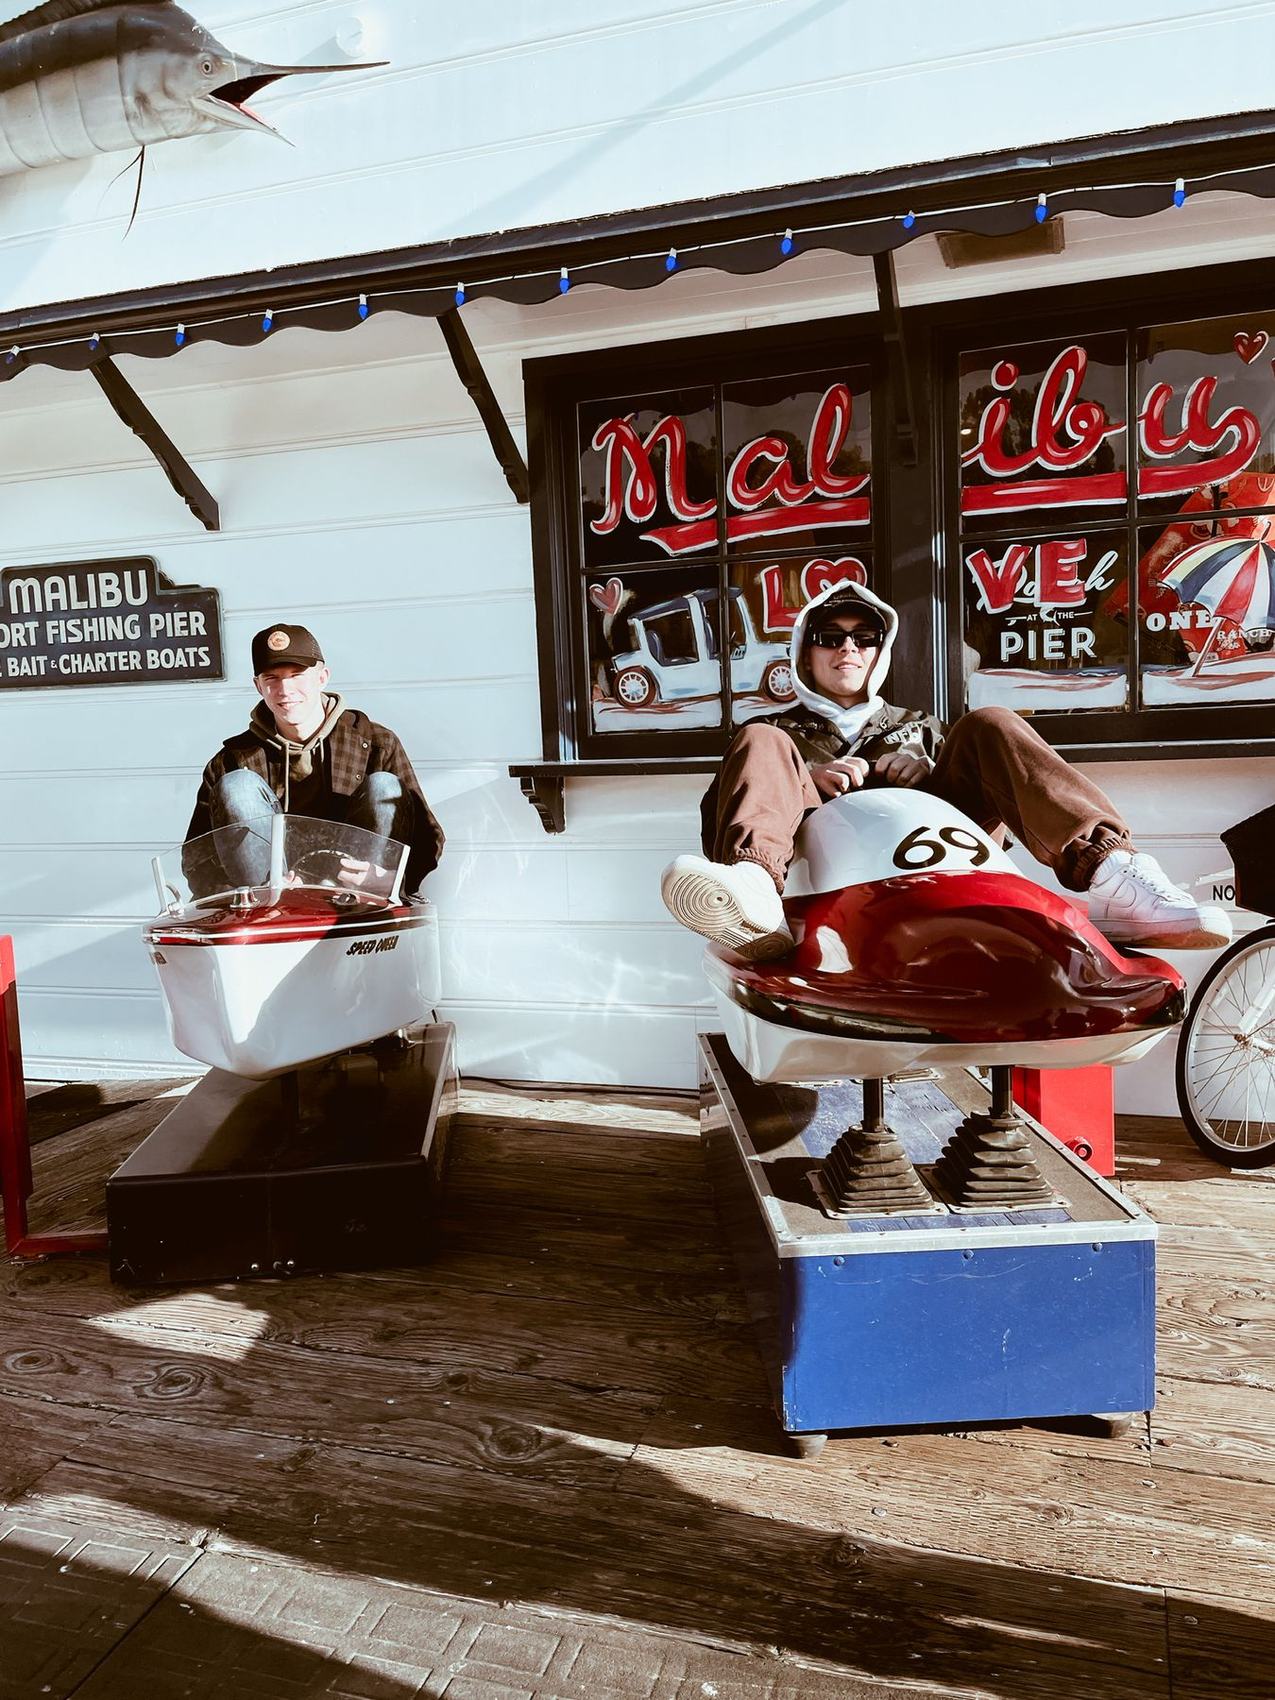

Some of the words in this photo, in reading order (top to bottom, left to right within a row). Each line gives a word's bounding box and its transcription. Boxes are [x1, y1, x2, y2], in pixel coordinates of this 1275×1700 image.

[9, 569, 148, 614] MALIBU
[46, 613, 141, 644] FISHING
[150, 611, 207, 638] PIER
[1026, 613, 1038, 621] AT
[1057, 611, 1075, 620] THE
[1146, 610, 1214, 632] ONE
[1000, 627, 1098, 663] PIER
[7, 655, 48, 677] BAIT
[50, 660, 58, 669] &
[59, 650, 142, 674] CHARTER
[147, 647, 211, 670] BOATS
[892, 826, 990, 870] 69
[1212, 884, 1236, 901] NO
[346, 939, 377, 956] SPEED
